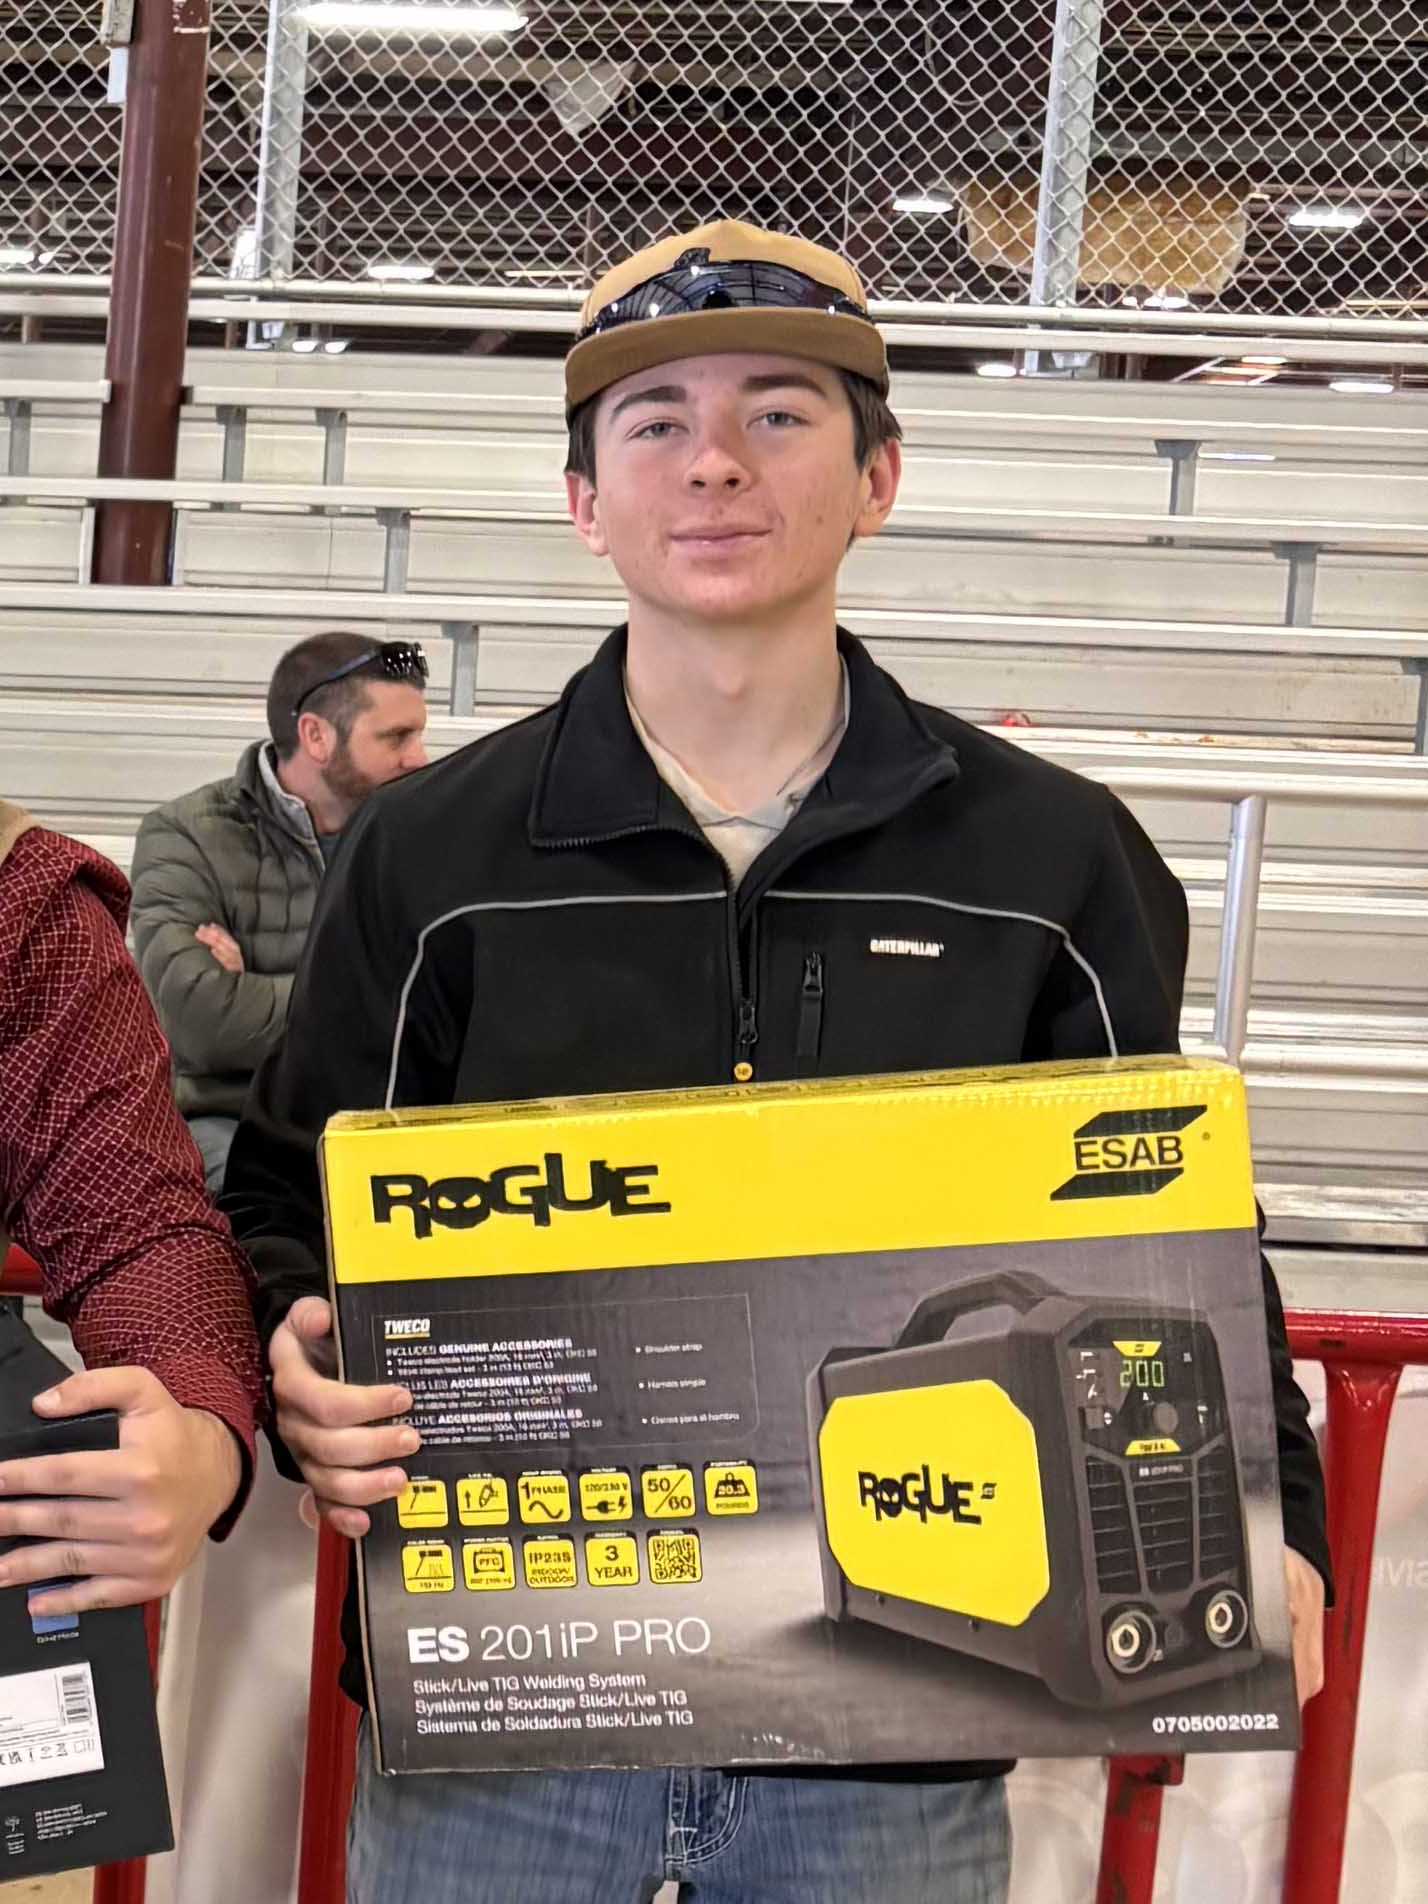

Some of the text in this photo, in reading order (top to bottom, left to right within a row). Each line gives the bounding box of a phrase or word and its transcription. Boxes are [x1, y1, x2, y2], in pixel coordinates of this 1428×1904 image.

[1074, 1135, 1184, 1171] ESAB
[370, 1152, 672, 1239] ROGUE
[384, 1318, 430, 1334] TWECO
[439, 1343, 489, 1354] GENUINE
[493, 1338, 572, 1352] ACCESSORIES
[450, 1375, 530, 1389] ACCESSOIRES
[1120, 1360, 1165, 1387] 200
[438, 1410, 512, 1424] ACCESORIOS
[605, 1545, 619, 1561] 3
[595, 1566, 633, 1579] YEAR
[407, 1617, 711, 1663] ES 201iP PRO
[413, 1673, 646, 1695] Stick/Live TIG Welding System
[484, 1697, 503, 1711] de
[507, 1694, 575, 1714] Soudage
[579, 1691, 656, 1709] Stick/Live
[659, 1690, 687, 1706] TIG
[417, 1710, 694, 1735] Sistema de Soldadura Stick/Live TIG
[1152, 1713, 1280, 1734] 0705002022
